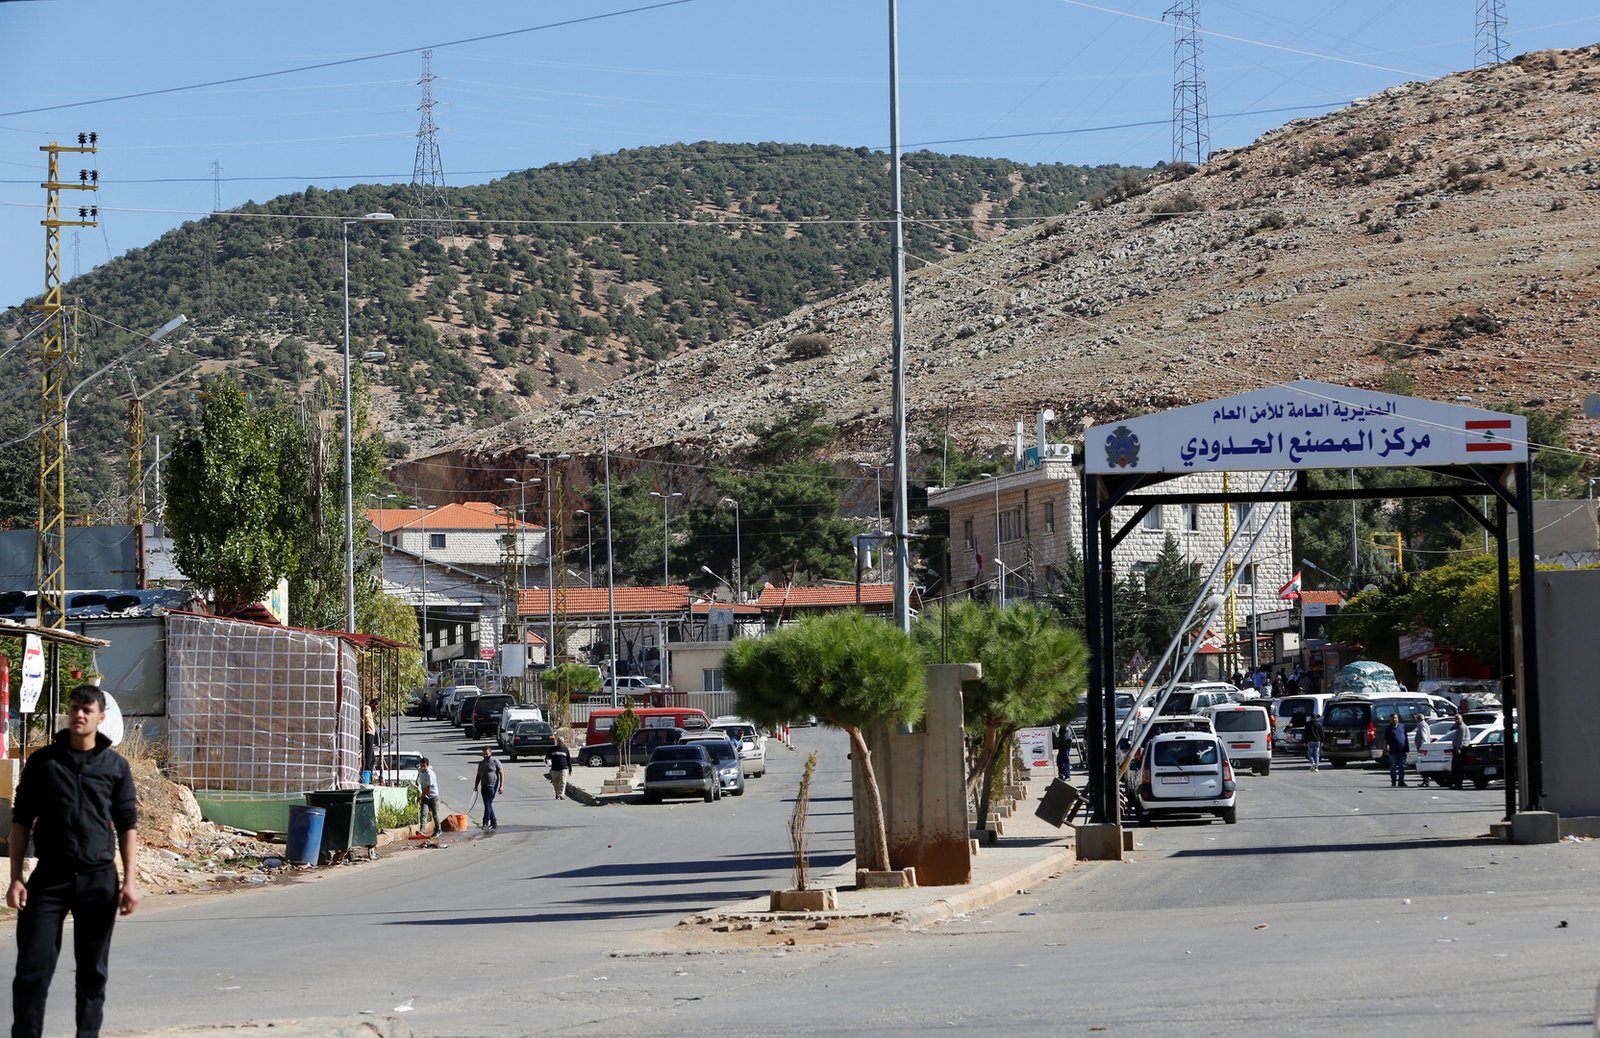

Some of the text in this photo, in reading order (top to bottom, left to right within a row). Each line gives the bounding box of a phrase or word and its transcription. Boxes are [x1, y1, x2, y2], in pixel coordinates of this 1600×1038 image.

[1212, 401, 1397, 425] المديرية العامة للأمن العام
[1180, 427, 1431, 467] مركز المصنع الحدودي
